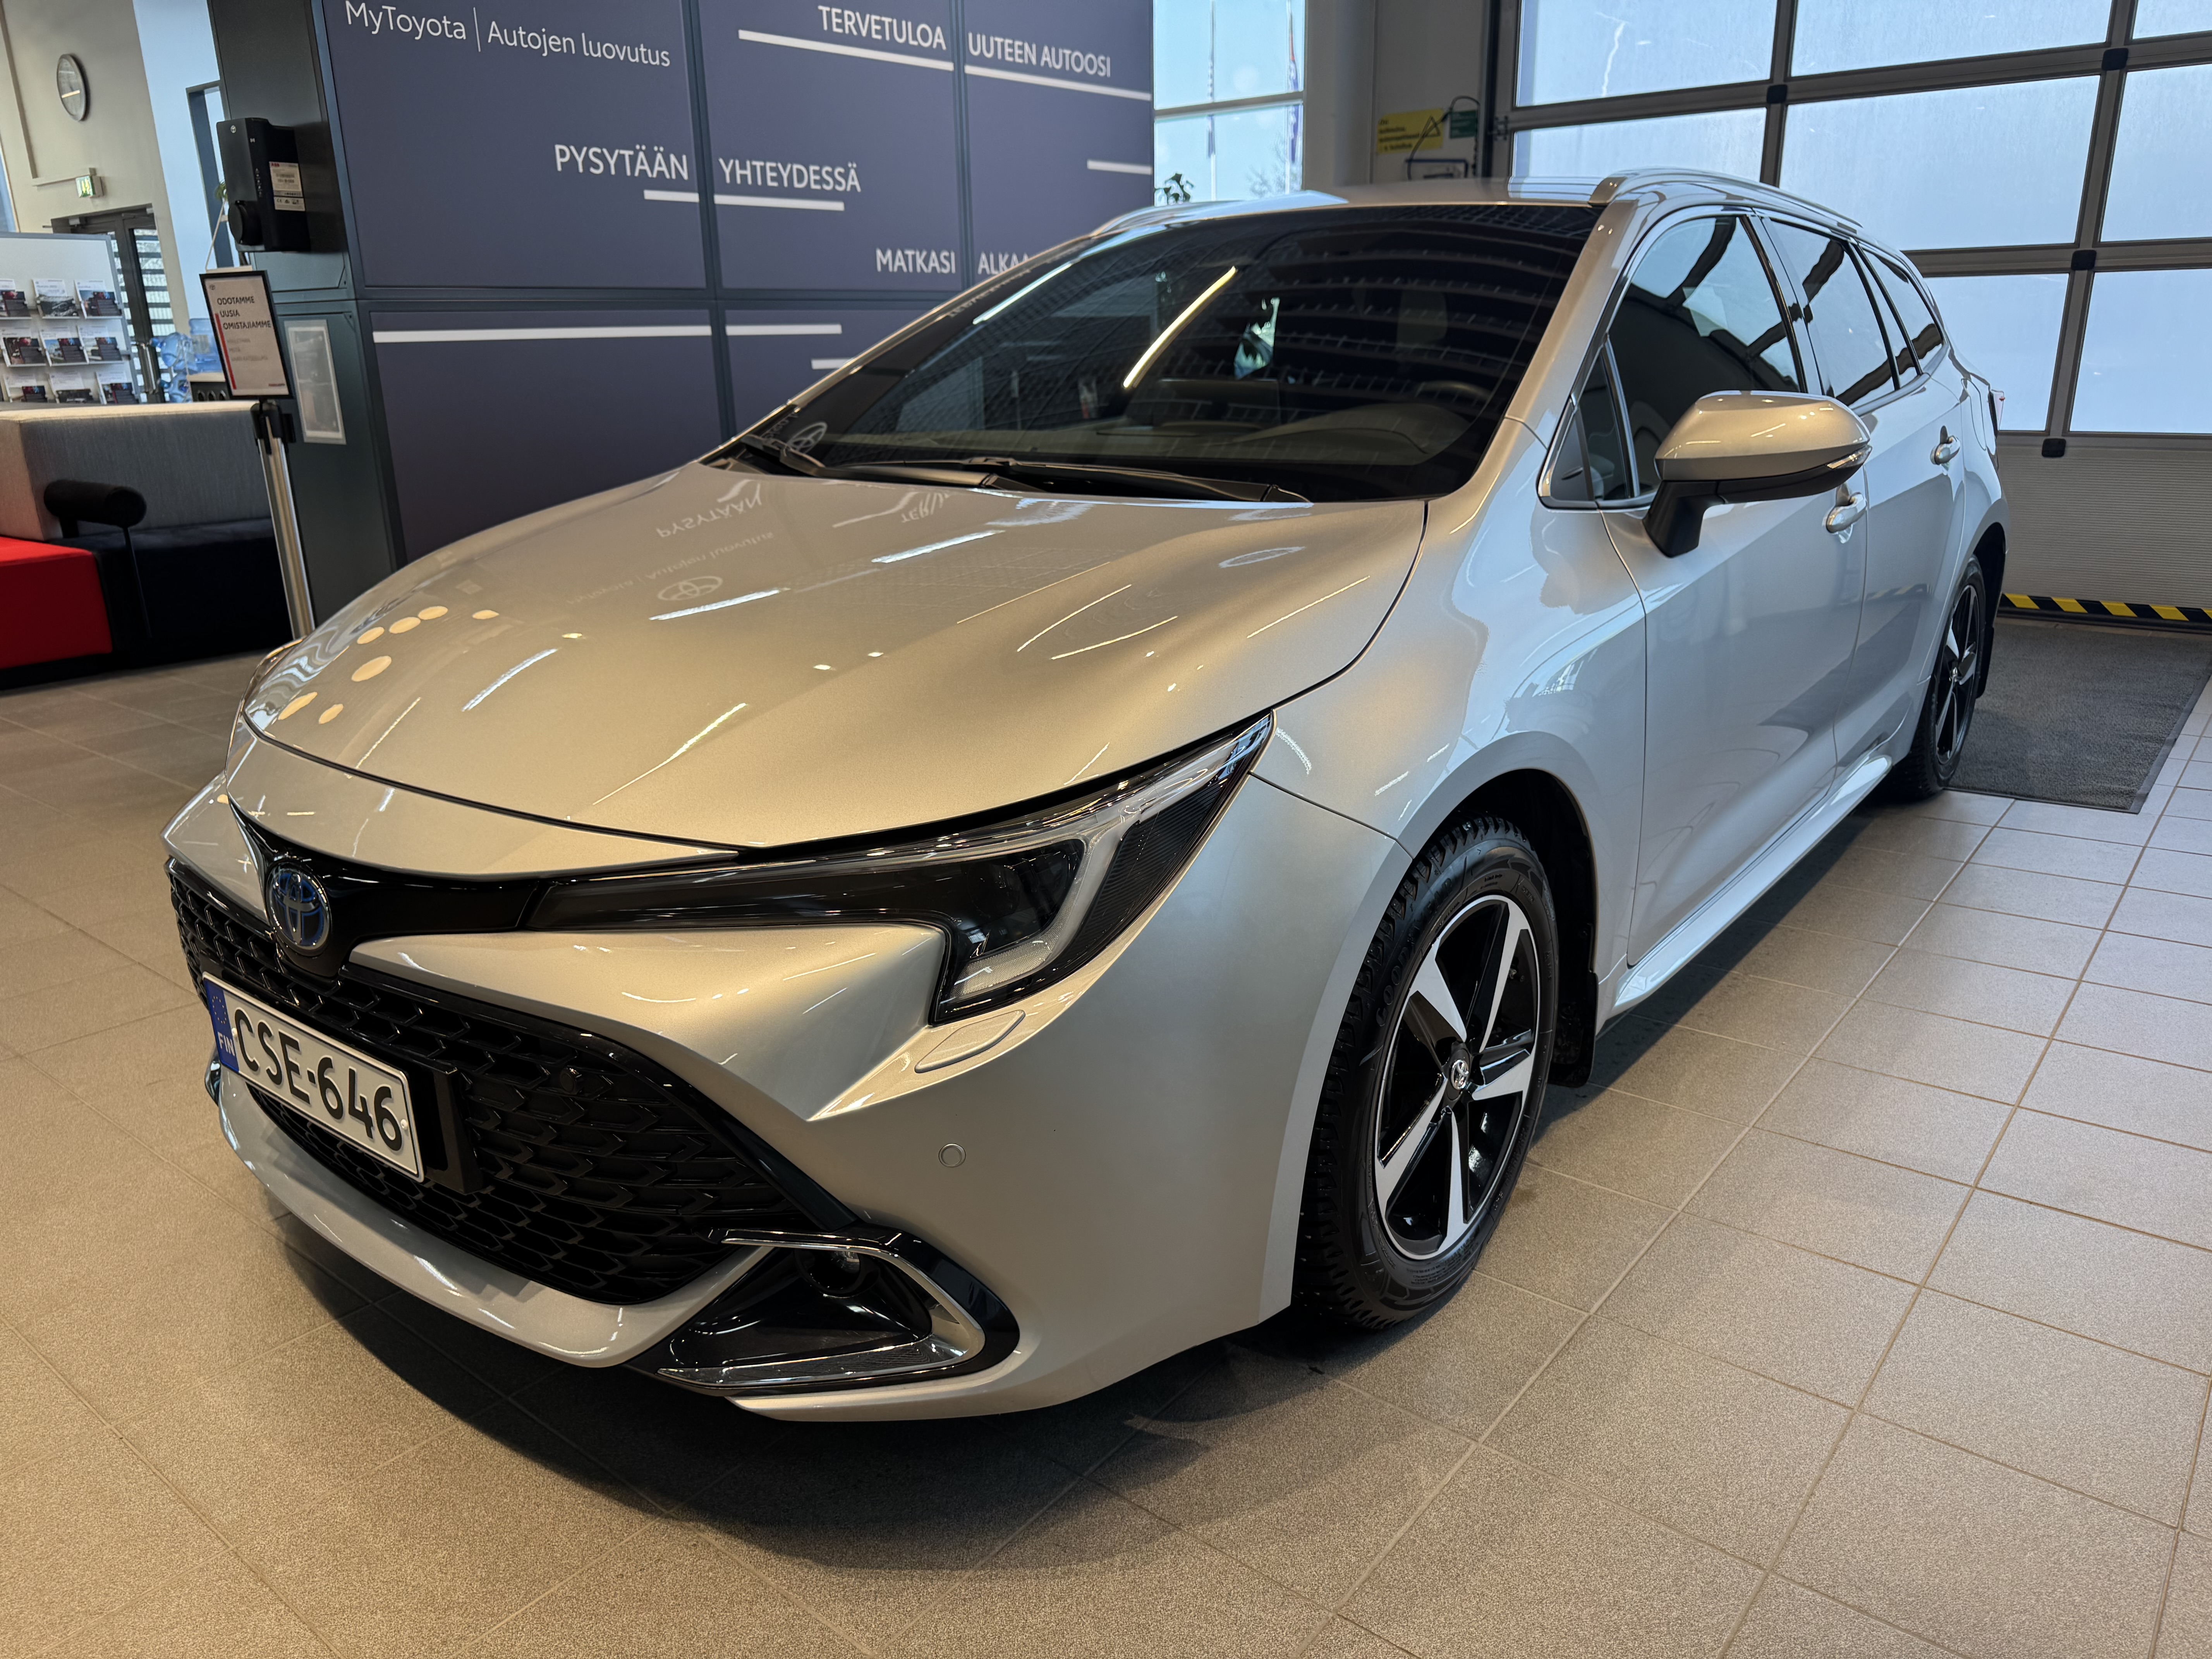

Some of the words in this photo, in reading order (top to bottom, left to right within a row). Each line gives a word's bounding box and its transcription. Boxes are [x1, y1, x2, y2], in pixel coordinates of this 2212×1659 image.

[345, 0, 466, 40] MyToyota
[488, 21, 575, 57] Autojen
[582, 33, 671, 67] luovutus
[817, 5, 947, 50] TERVETULOA
[968, 32, 1037, 65] UUTEEN
[1040, 45, 1111, 77] AUTOOSI
[554, 144, 689, 180] PYSYTÄÄN
[718, 158, 862, 193] YHTEYDESSÄ
[876, 248, 956, 274] MATKASI
[217, 296, 255, 305] ODOTAMME
[220, 309, 240, 318] UUSIA
[223, 320, 271, 330] OMISTAJIAMME
[217, 1032, 236, 1057] FIN
[234, 1008, 403, 1152] CSE-646
